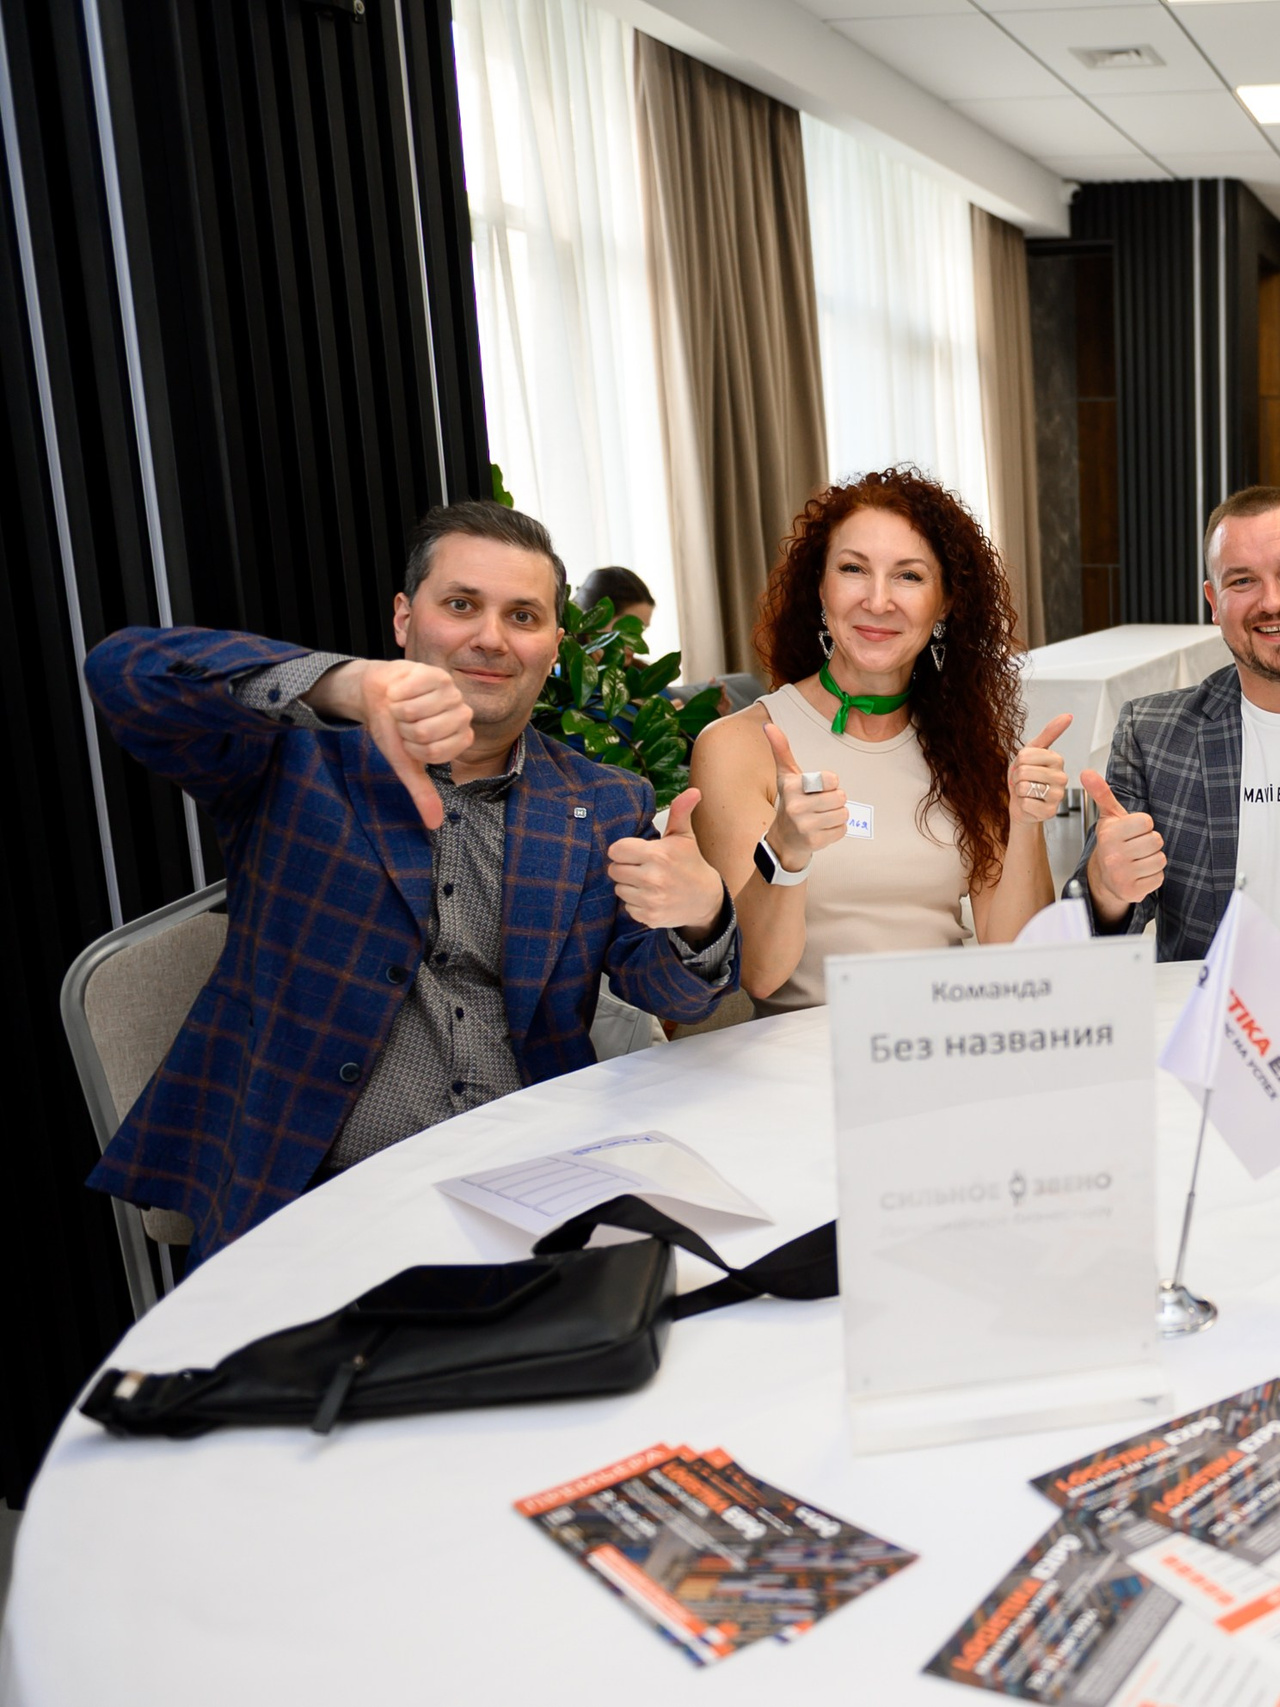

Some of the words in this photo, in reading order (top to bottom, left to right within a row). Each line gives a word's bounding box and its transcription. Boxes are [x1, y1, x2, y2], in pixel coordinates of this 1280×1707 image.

[932, 976, 1053, 1004] Команда
[870, 1031, 935, 1065] Без
[944, 1022, 1114, 1060] названия
[1227, 989, 1271, 1057] TIKA
